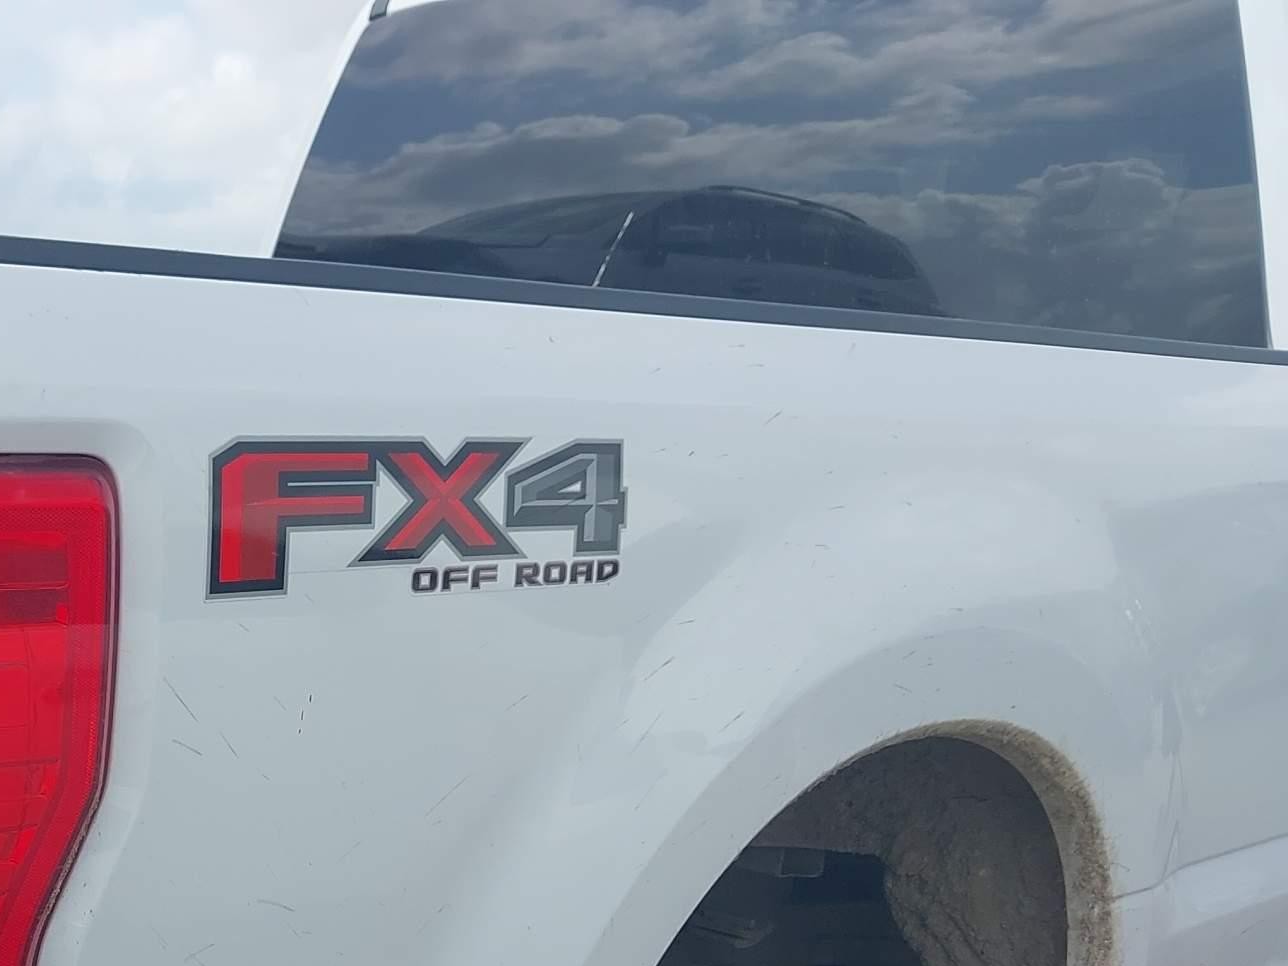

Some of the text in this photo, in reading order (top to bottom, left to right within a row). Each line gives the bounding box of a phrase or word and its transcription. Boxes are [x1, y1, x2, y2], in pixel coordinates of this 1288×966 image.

[206, 435, 628, 602] FX4
[412, 559, 619, 594] OFF ROAD
